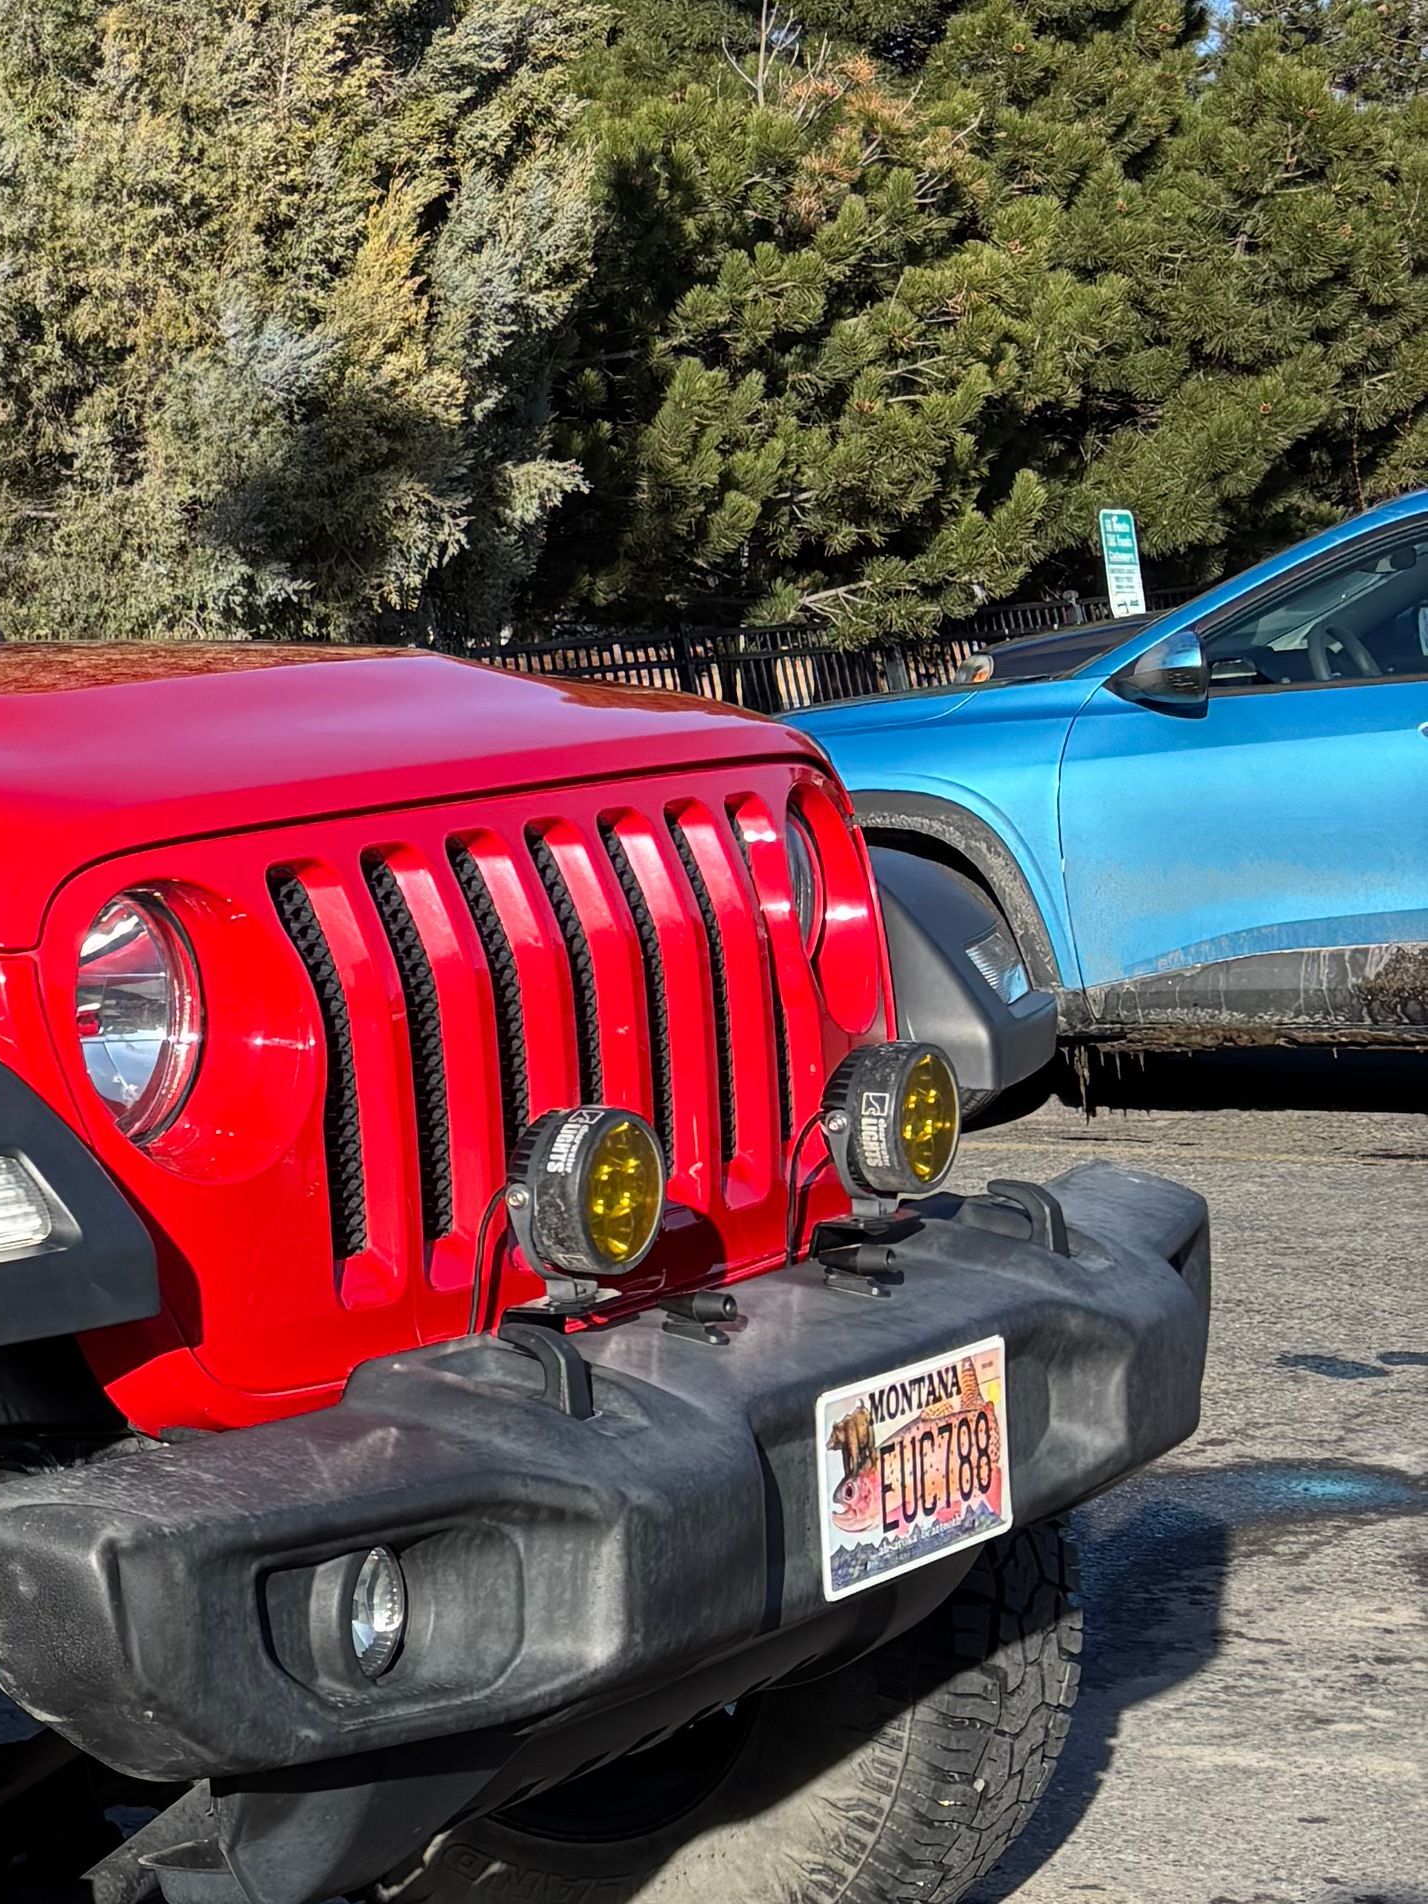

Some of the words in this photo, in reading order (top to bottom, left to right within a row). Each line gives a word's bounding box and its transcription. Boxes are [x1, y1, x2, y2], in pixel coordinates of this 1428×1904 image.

[547, 1123, 581, 1174] LIGHTS
[861, 1118, 883, 1167] LIGHTS
[868, 1365, 962, 1426] MONTANA
[879, 1409, 993, 1534] EUC788
